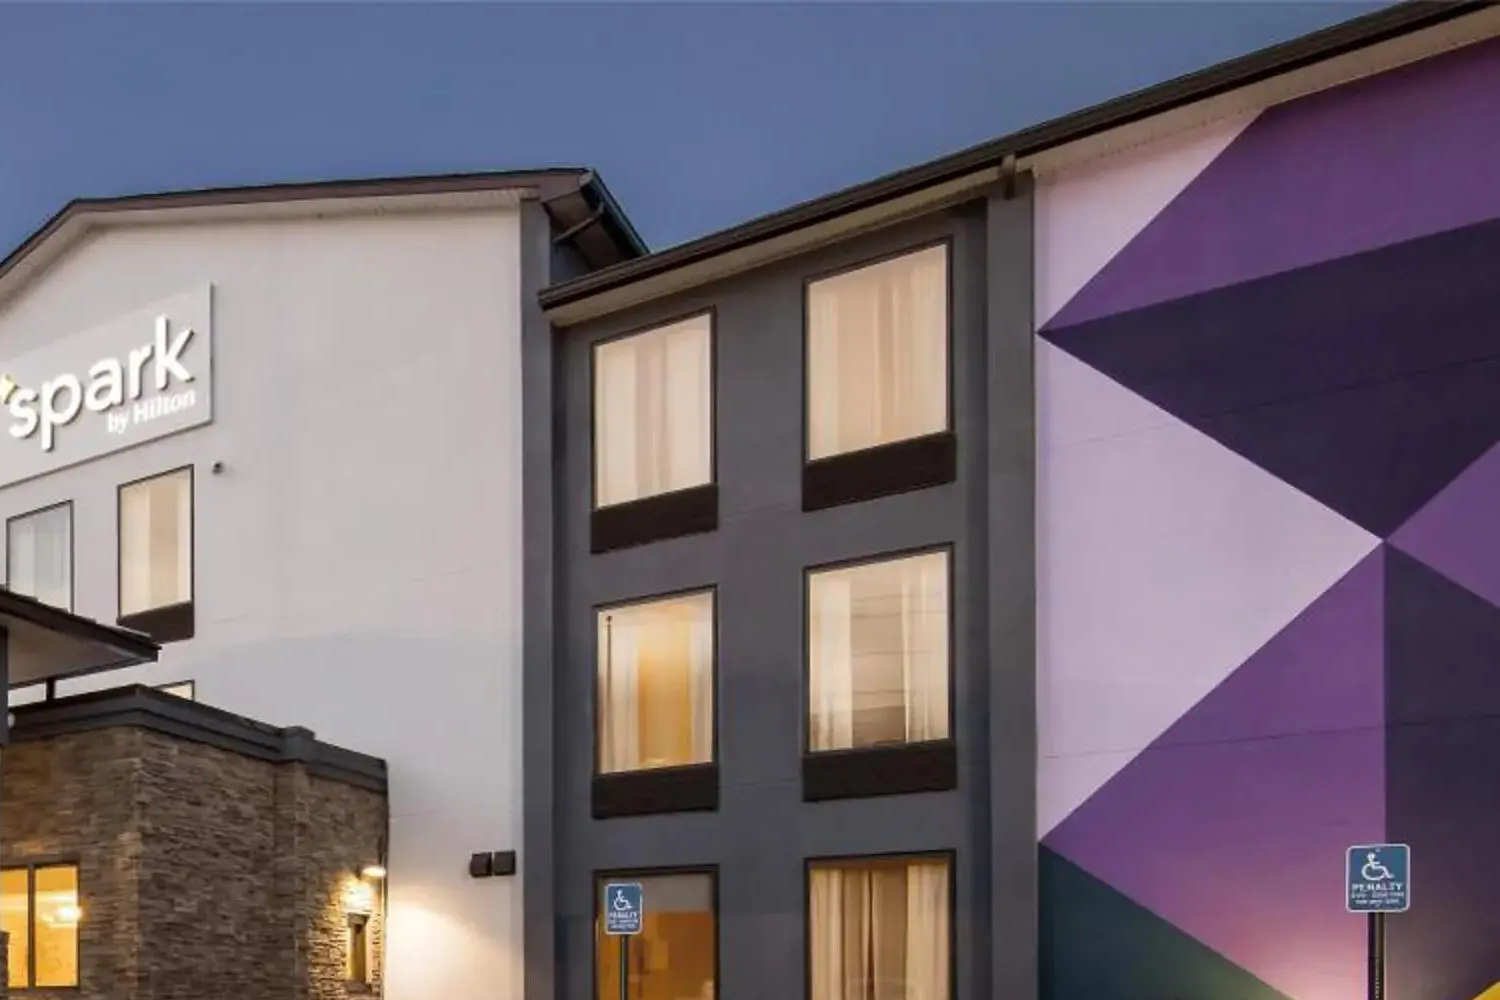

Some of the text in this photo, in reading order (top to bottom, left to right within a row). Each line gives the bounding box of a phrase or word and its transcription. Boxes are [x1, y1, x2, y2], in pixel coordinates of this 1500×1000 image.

[9, 314, 195, 452] spark
[107, 388, 196, 434] by Hilton
